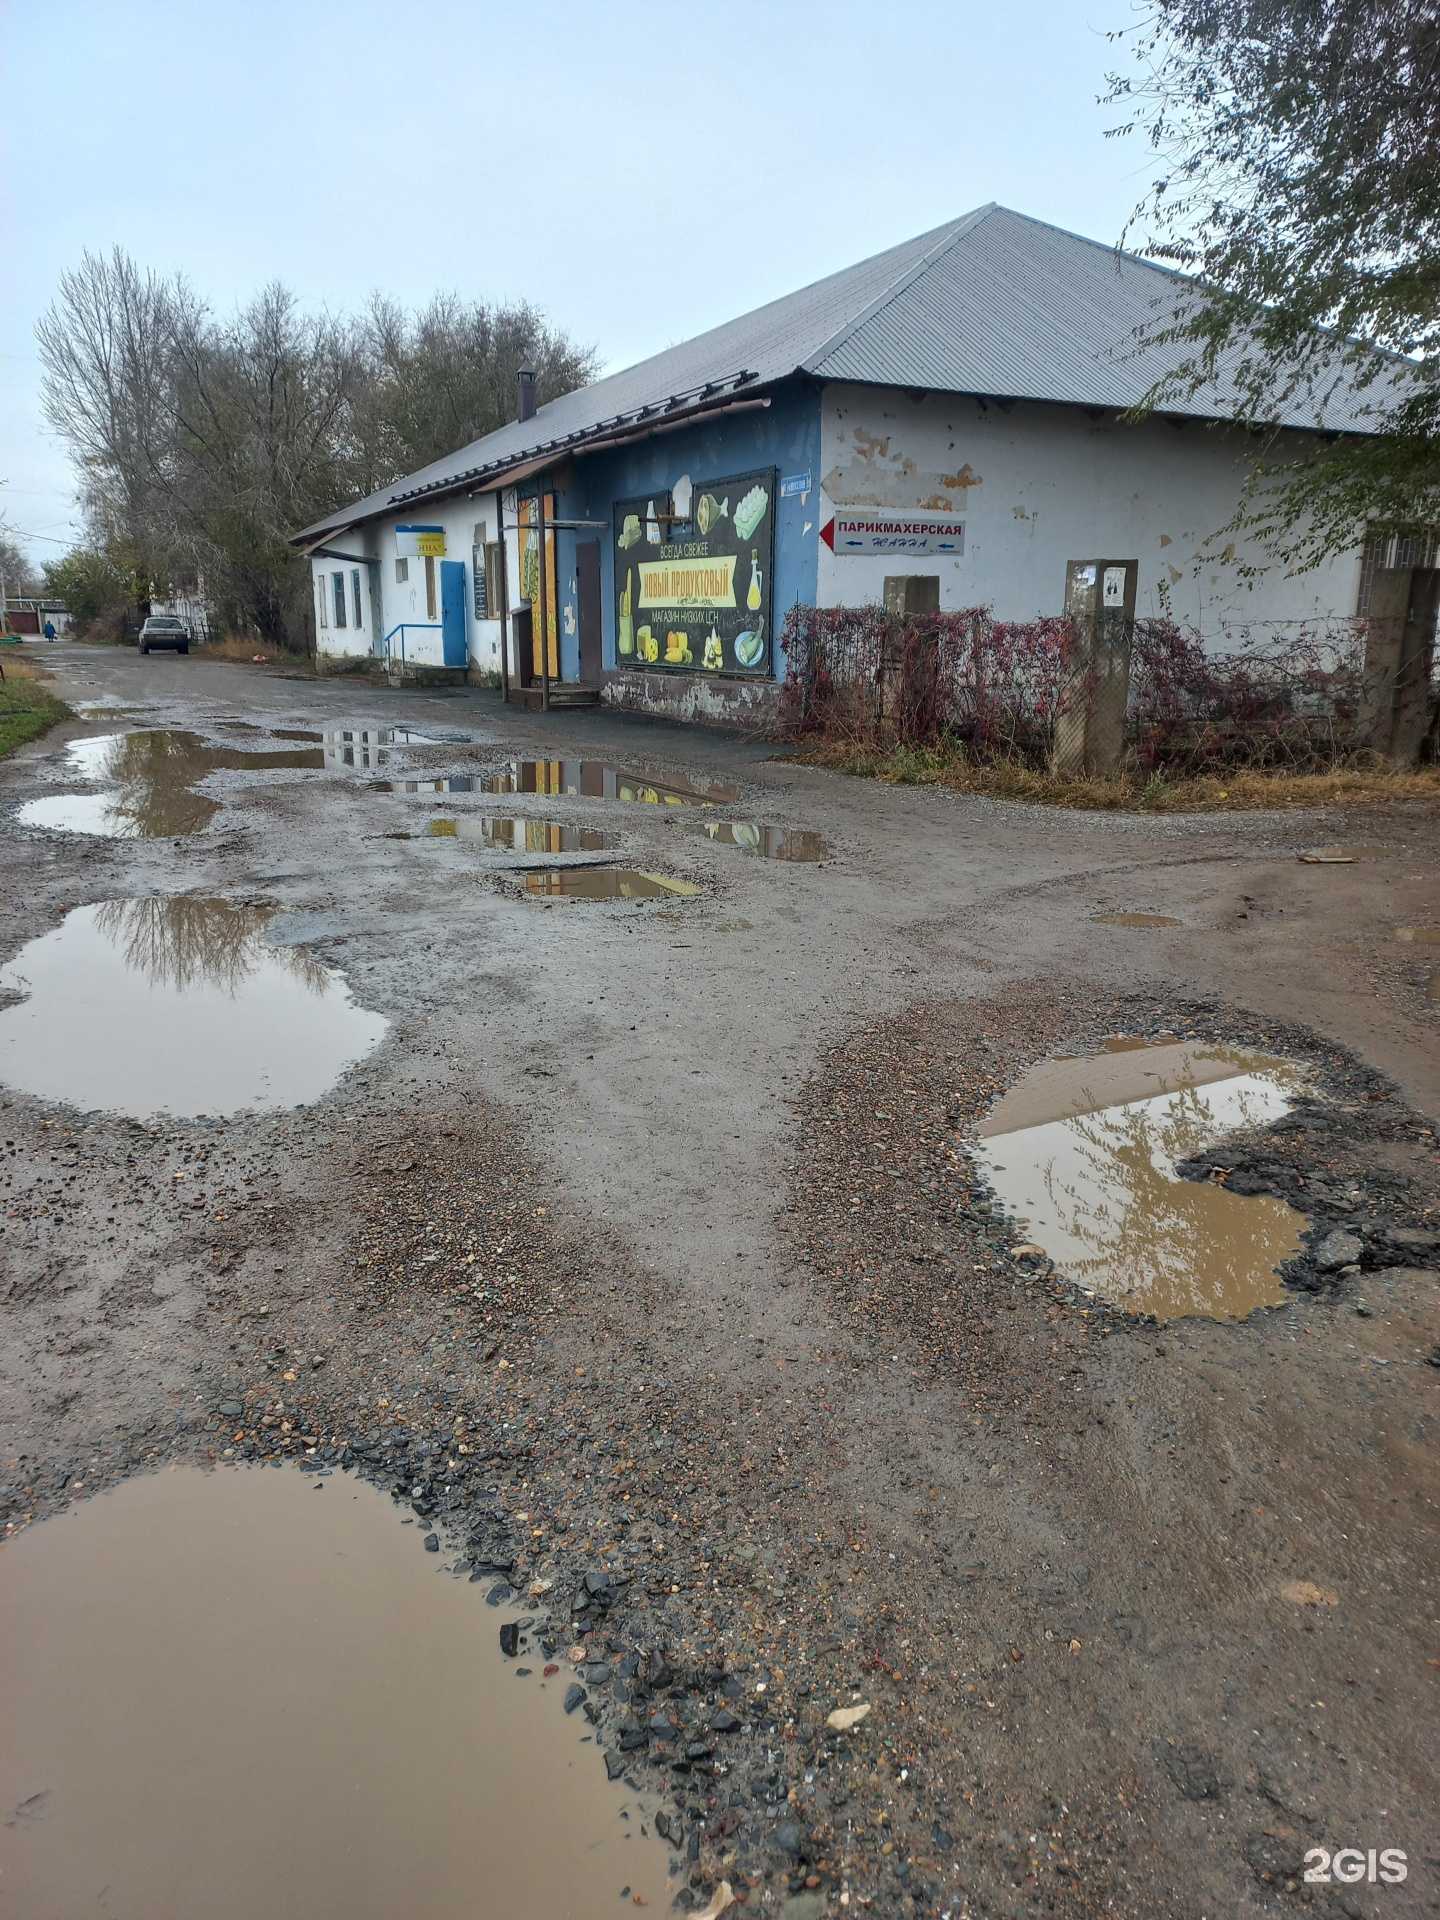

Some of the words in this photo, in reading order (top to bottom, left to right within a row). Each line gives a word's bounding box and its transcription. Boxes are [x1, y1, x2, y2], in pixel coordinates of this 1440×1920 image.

[838, 521, 962, 535] ПАРИКМАХЕРСКАЯ
[660, 543, 683, 559] ВСЕГДА
[684, 542, 709, 557] СВЕЖЕЕ
[644, 567, 669, 598] НОВЫЙ
[671, 563, 729, 598] ПРОДУКТОВЫЙ
[652, 610, 680, 624] МАГАЗИН
[680, 610, 705, 624] НИЗКИХ
[705, 611, 719, 625] ЦЕН
